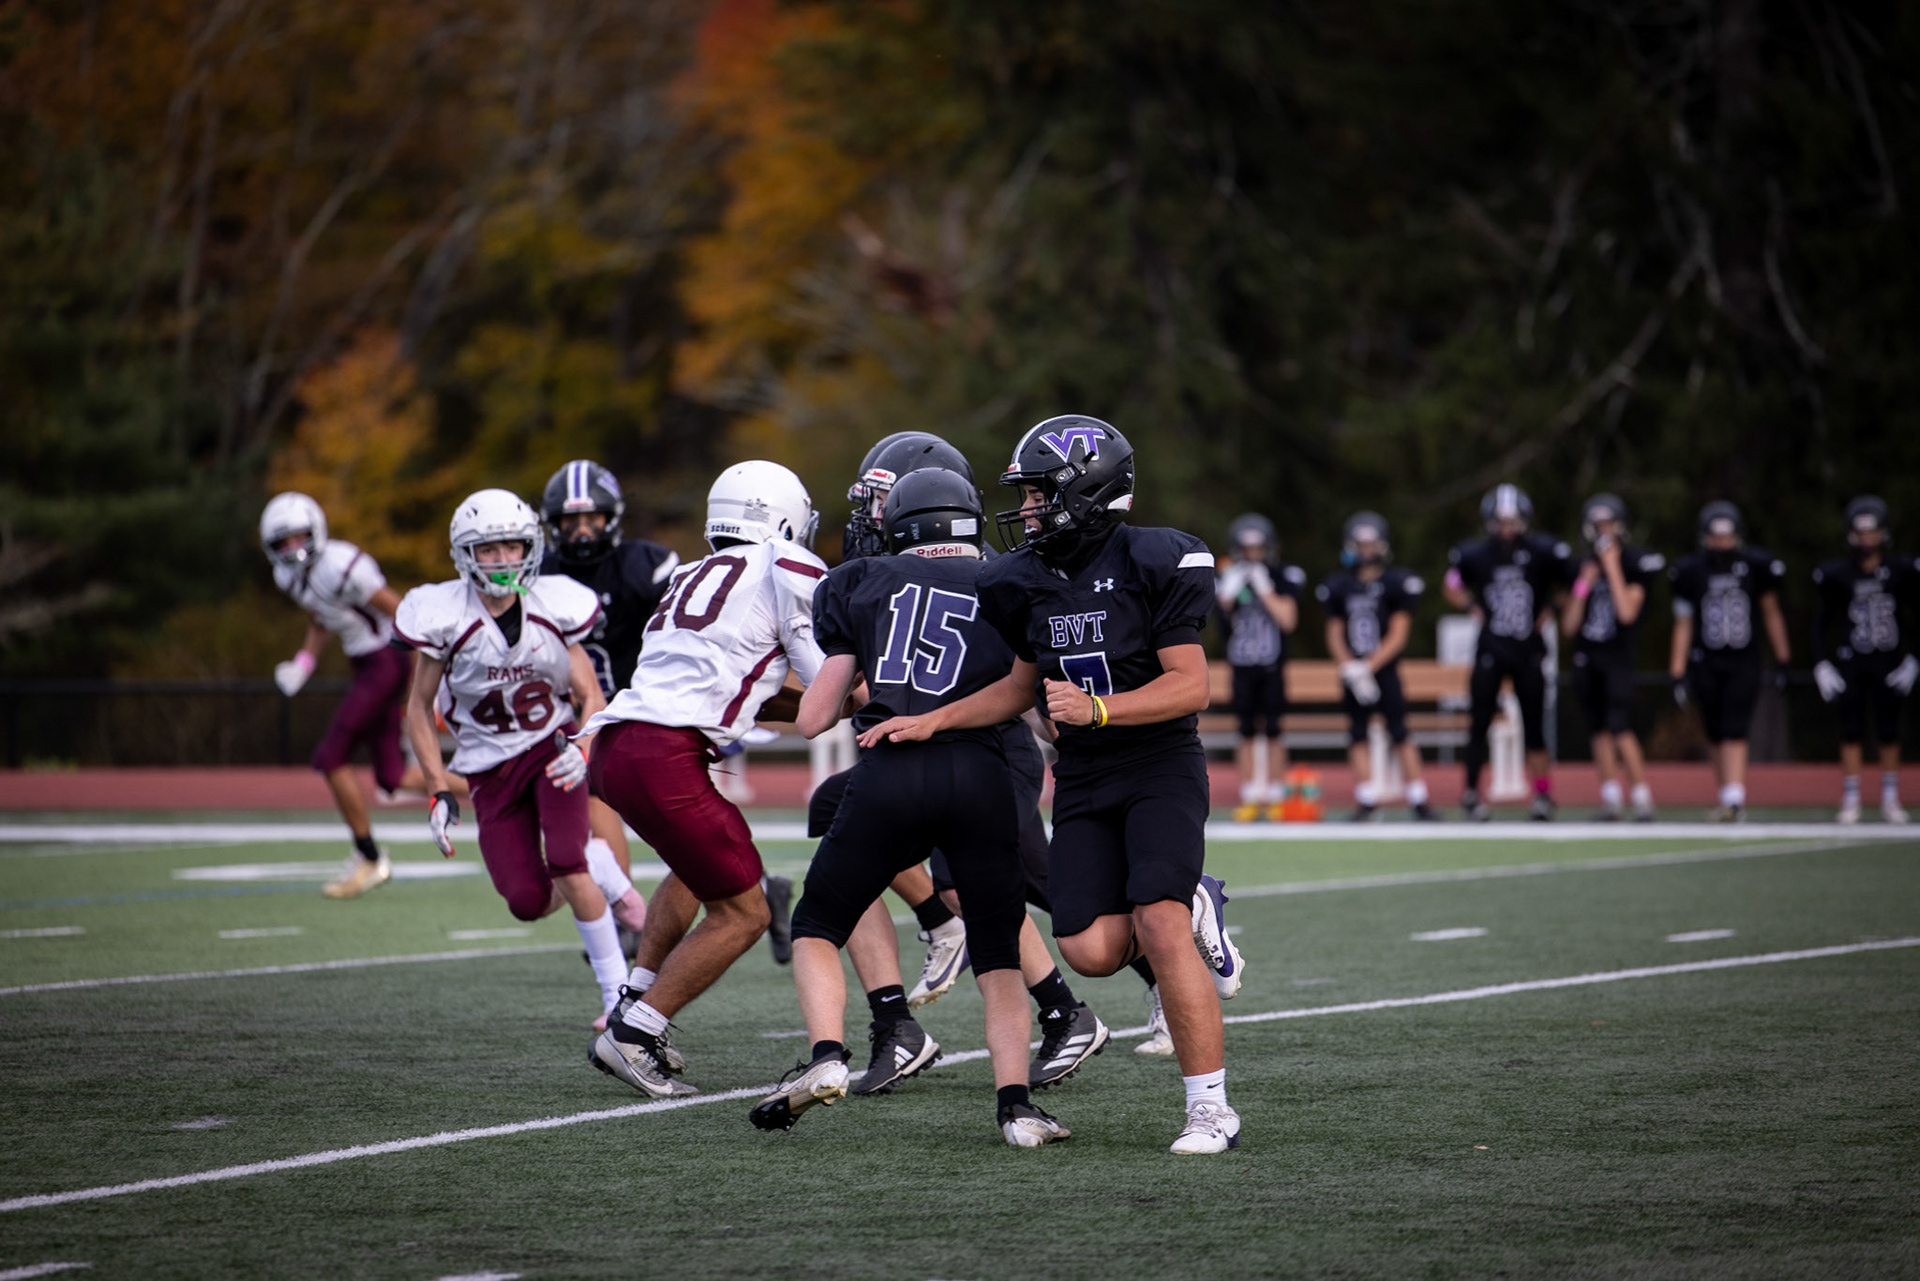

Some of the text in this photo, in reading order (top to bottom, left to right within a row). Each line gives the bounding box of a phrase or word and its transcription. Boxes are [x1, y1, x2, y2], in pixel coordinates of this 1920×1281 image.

[1038, 426, 1106, 464] VT
[711, 524, 741, 534] schutt
[916, 546, 963, 557] Riddell
[875, 583, 979, 695] 15
[1048, 610, 1107, 648] BVT
[487, 663, 535, 681] RAMS
[470, 680, 555, 734] 46
